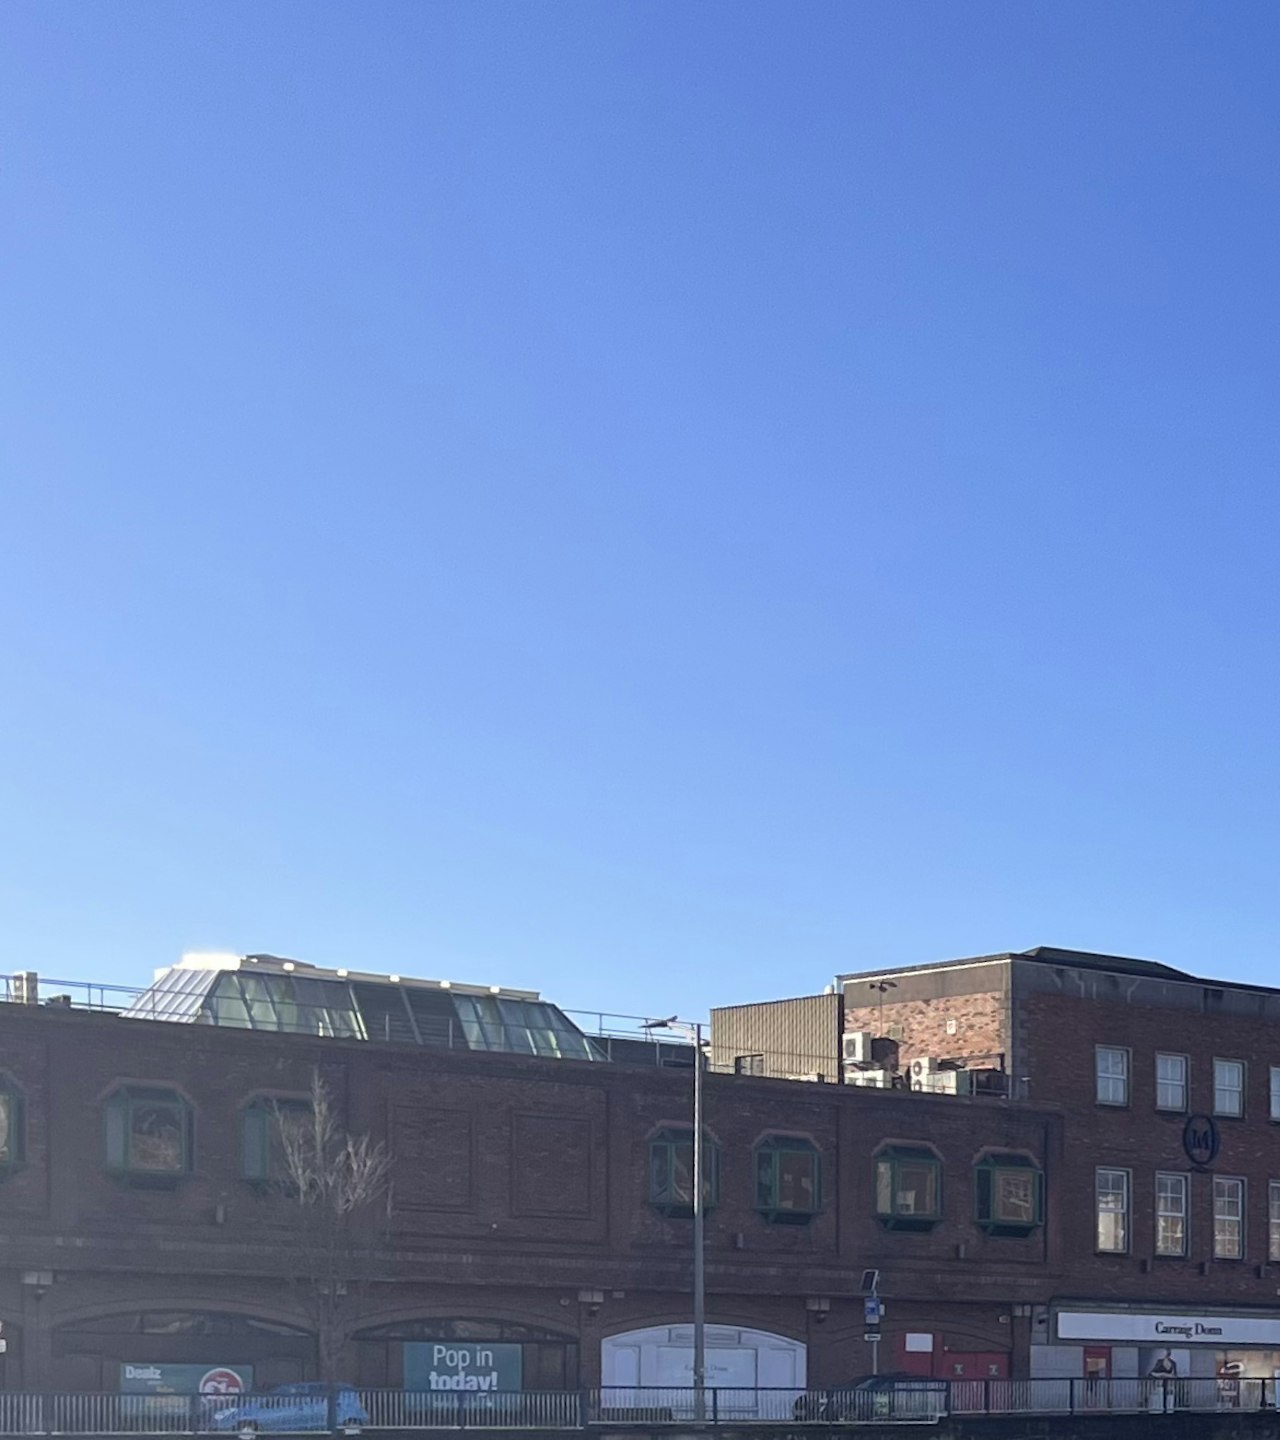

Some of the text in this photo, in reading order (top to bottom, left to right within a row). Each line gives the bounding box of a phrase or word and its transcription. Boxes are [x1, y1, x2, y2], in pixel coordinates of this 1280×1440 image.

[1194, 1322, 1223, 1336] Donn
[433, 1344, 493, 1371] Pop in
[125, 1366, 162, 1380] Dealz
[429, 1371, 498, 1397] today!
